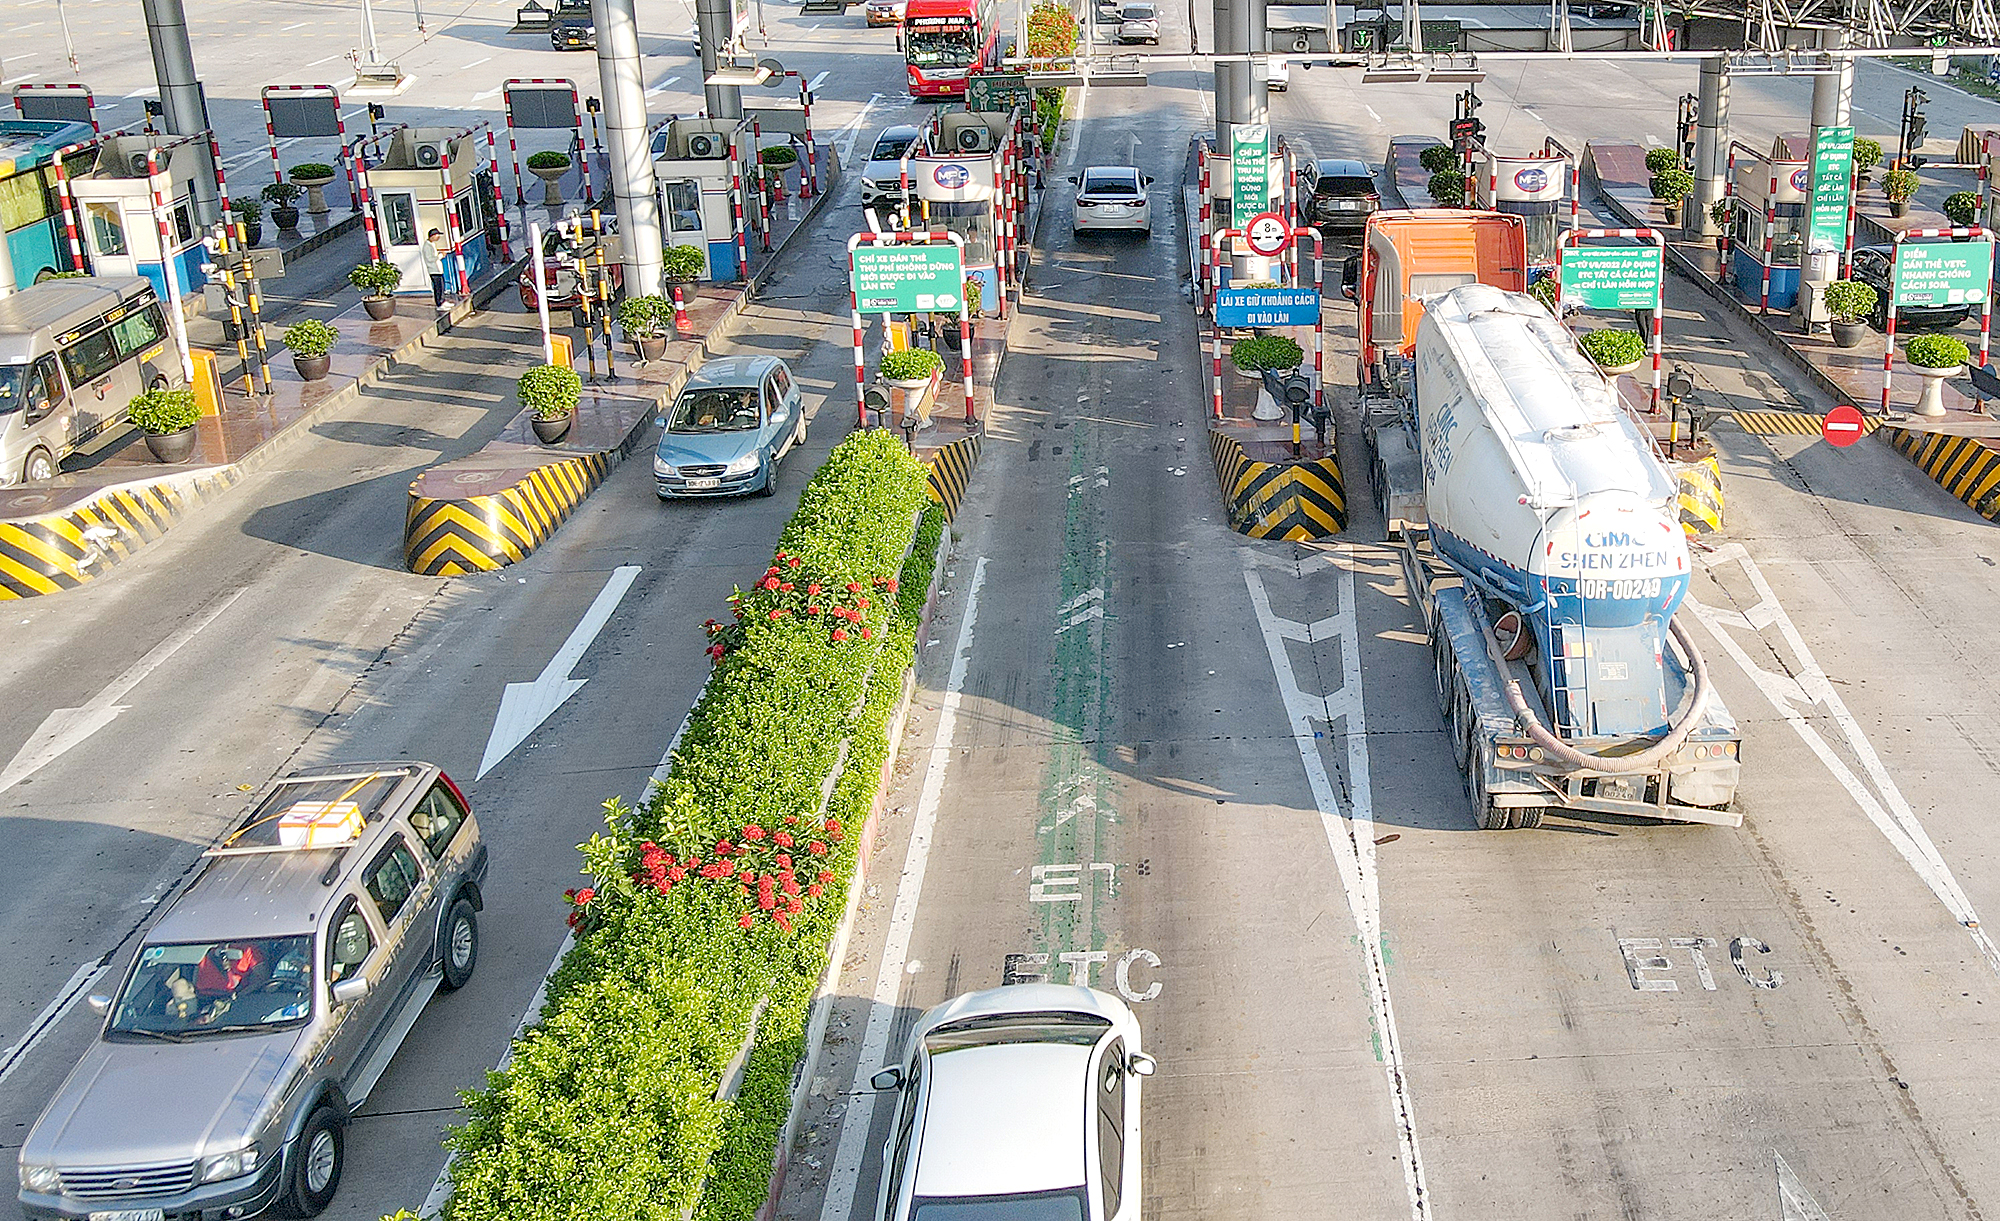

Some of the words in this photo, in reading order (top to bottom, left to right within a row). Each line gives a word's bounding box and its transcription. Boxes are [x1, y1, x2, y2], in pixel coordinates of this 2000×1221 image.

[876, 254, 888, 263] XE
[890, 253, 908, 263] DÁN
[859, 264, 877, 272] THU
[879, 263, 894, 272] PHÍ
[896, 262, 928, 272] KHÔNG
[1944, 260, 1967, 268] VETC
[1902, 270, 1936, 280] NHANH
[880, 282, 895, 290] ETC
[1235, 296, 1244, 306] XE
[1262, 292, 1293, 306] KHOẢNG
[1294, 293, 1315, 306] CÁCH
[1257, 311, 1272, 324] VÀO
[1274, 310, 1290, 323] LÀN
[1617, 937, 1784, 992] ETC
[1002, 948, 1163, 1002] ETC
